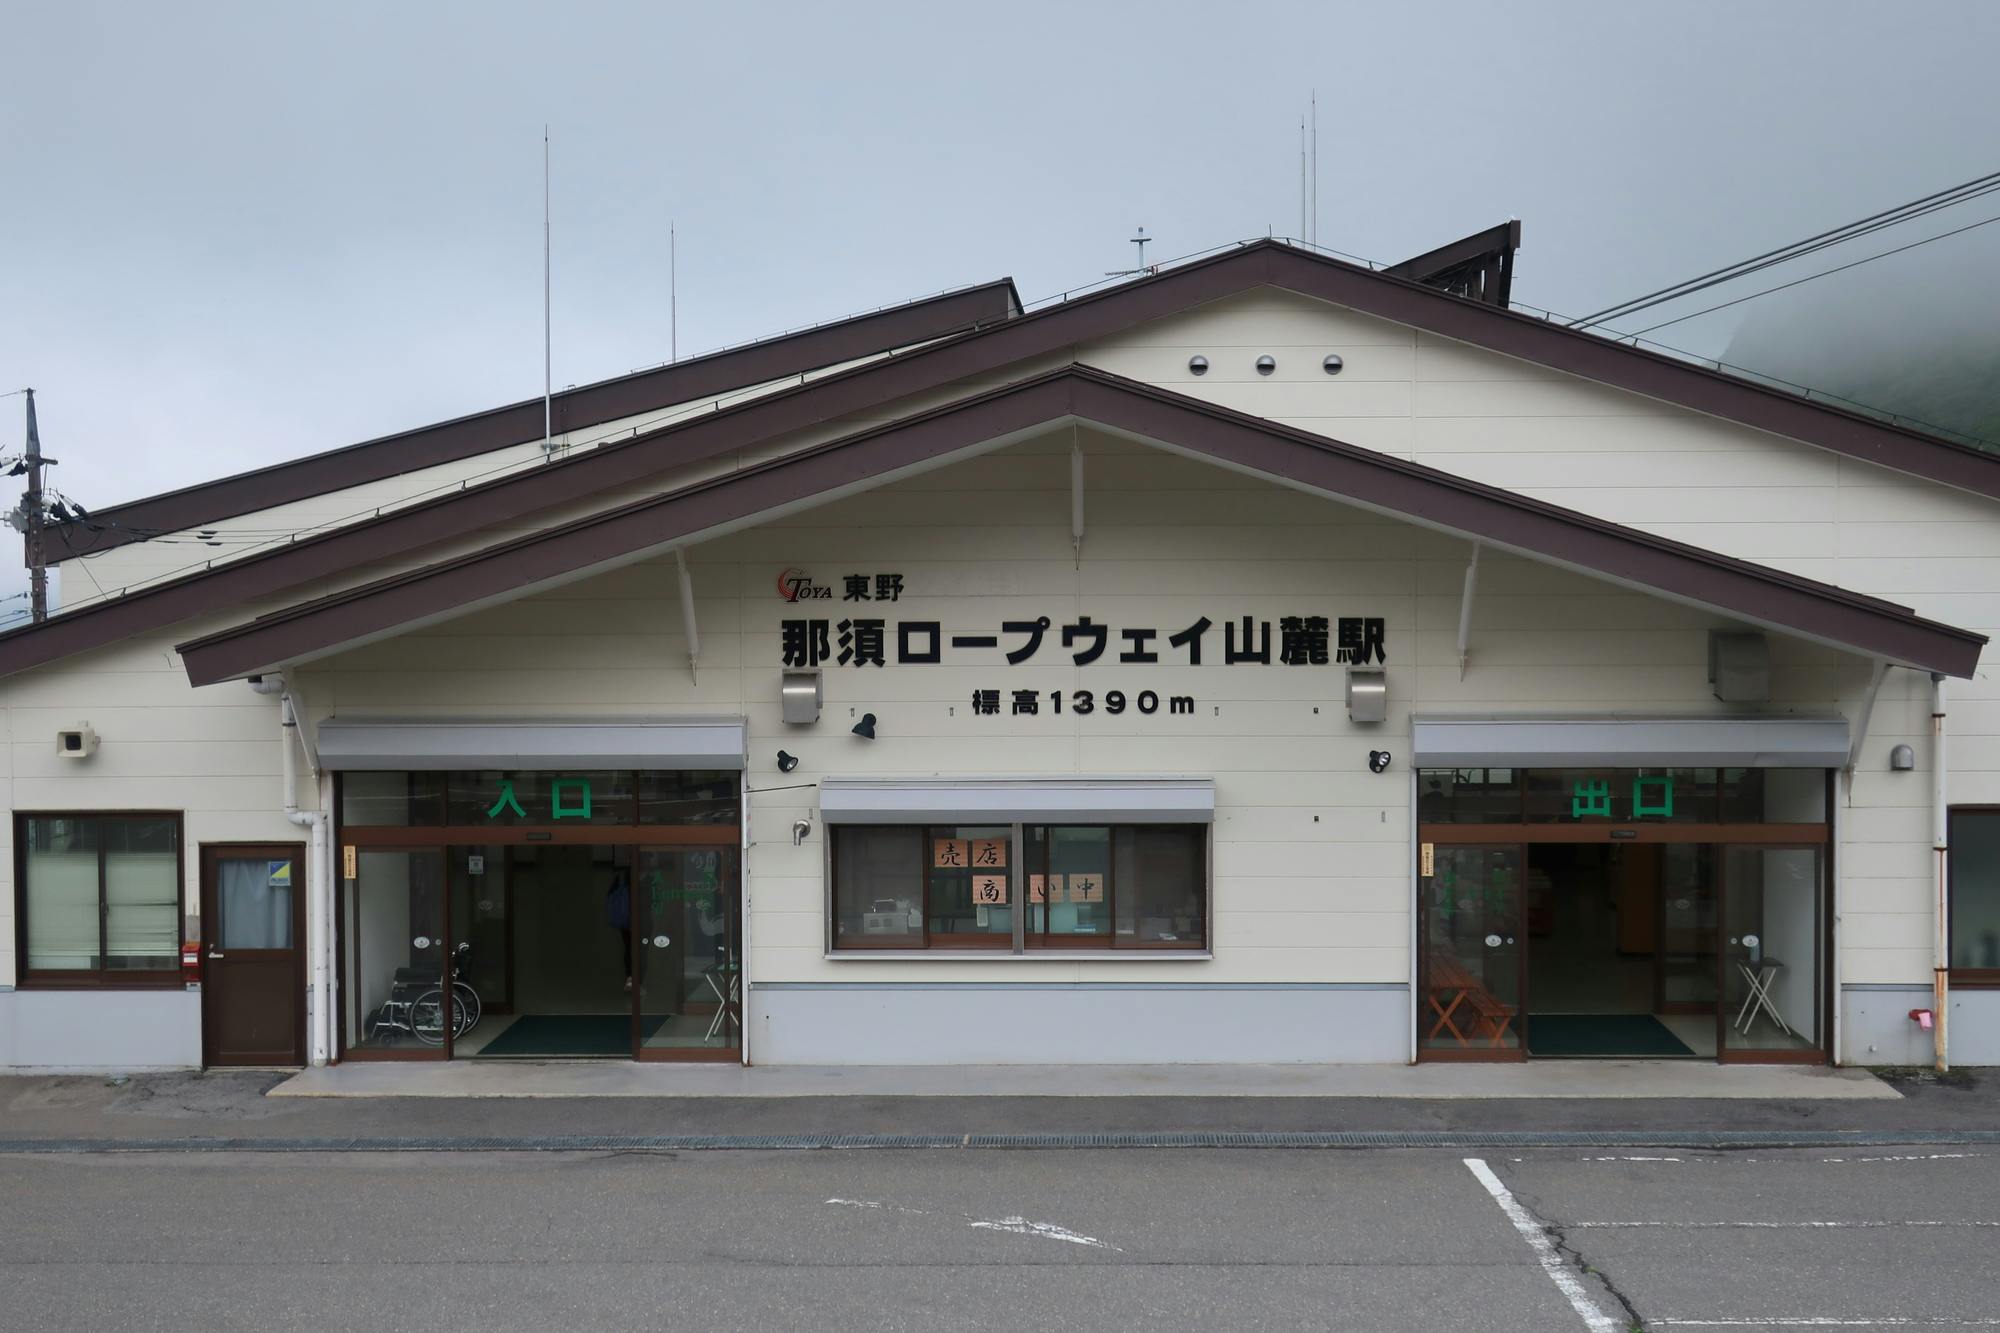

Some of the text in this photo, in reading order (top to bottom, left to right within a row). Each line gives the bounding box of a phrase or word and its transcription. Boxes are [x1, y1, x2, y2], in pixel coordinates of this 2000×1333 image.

[842, 573, 905, 602] 東野
[781, 615, 1386, 668] 那須ロープウェイ山麓駅
[488, 779, 591, 819] 入口
[1572, 777, 1673, 818] 出口
[941, 843, 997, 865] 売店
